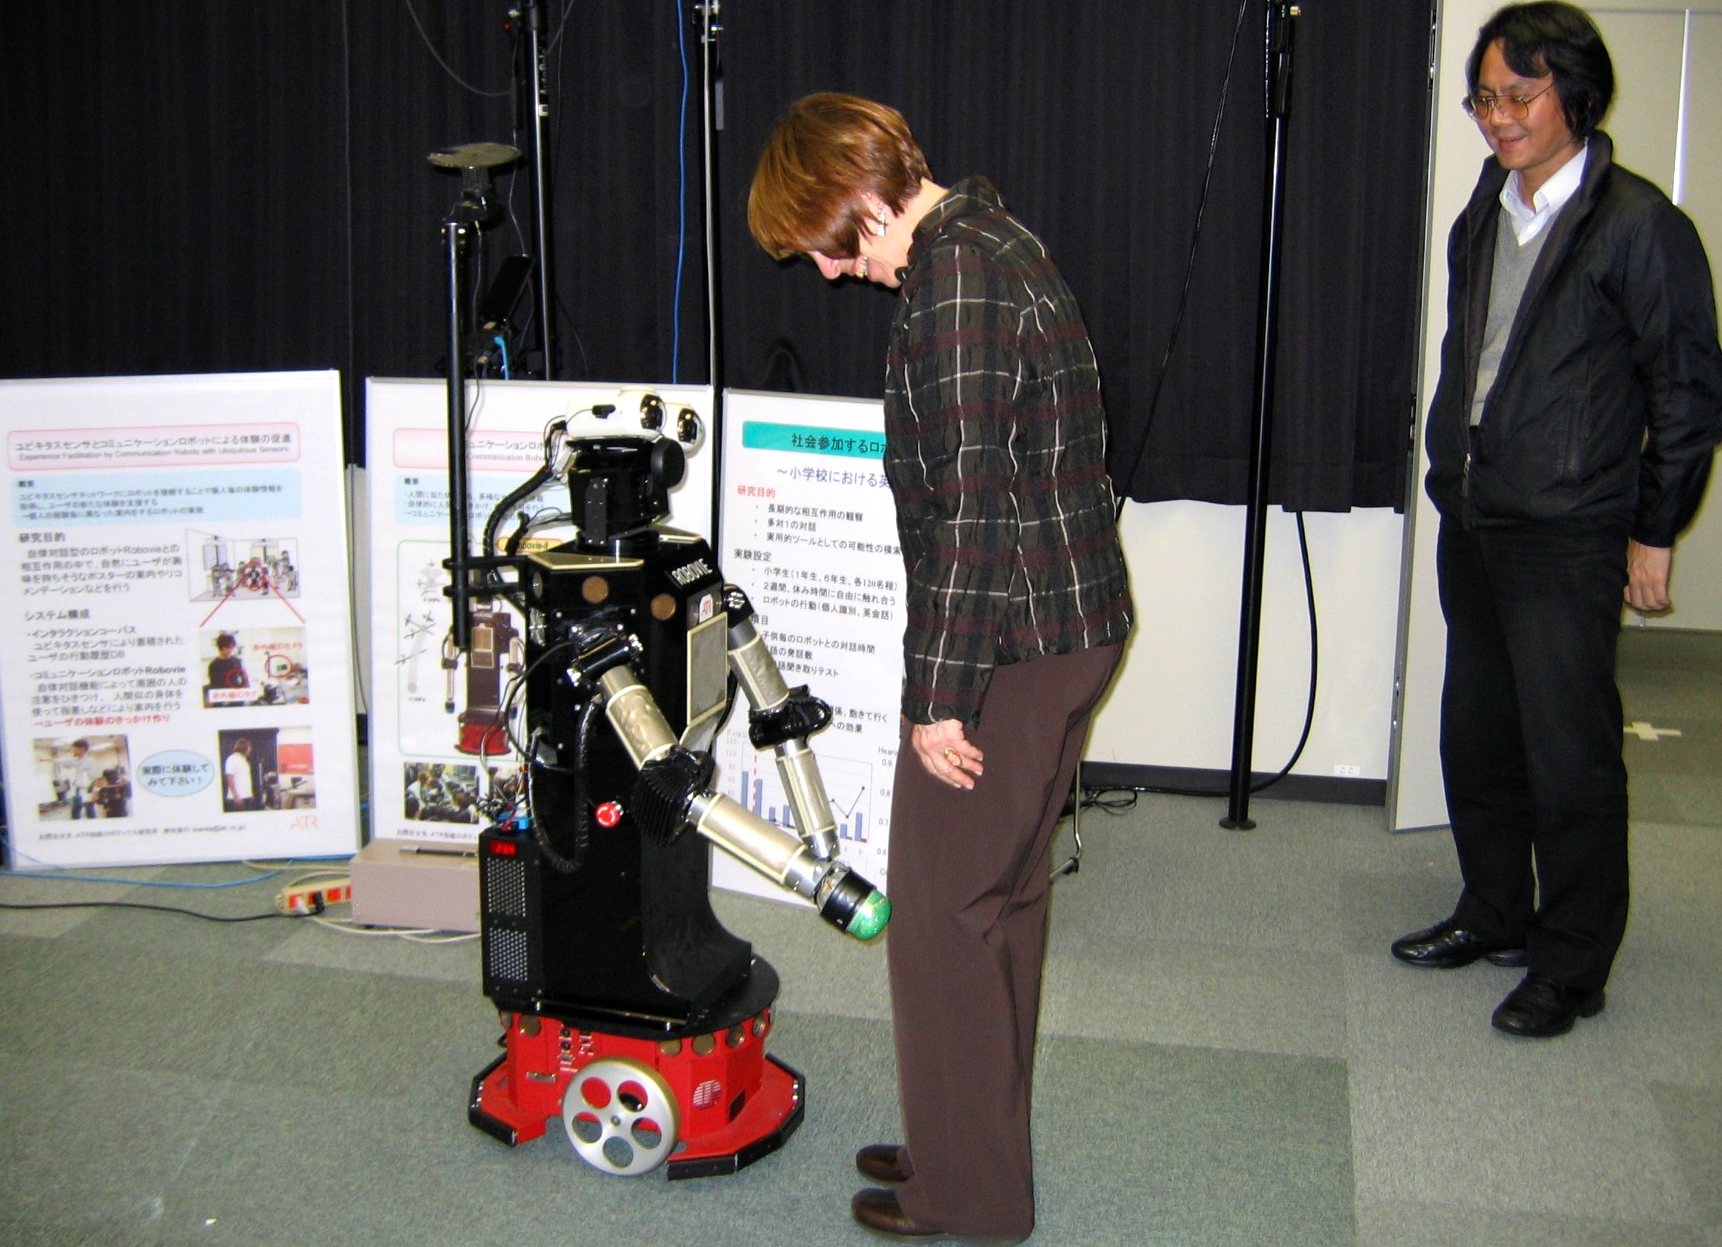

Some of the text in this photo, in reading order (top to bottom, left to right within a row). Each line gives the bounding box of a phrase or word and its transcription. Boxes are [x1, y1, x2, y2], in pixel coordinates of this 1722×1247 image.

[737, 485, 776, 499] 研究目的
[767, 504, 864, 523] 長期的な相互作用の観察
[767, 518, 817, 533] 多対1の対話
[19, 532, 66, 543] 研究目的
[733, 549, 772, 563] 実験設定
[671, 557, 713, 586] ROBOVIE
